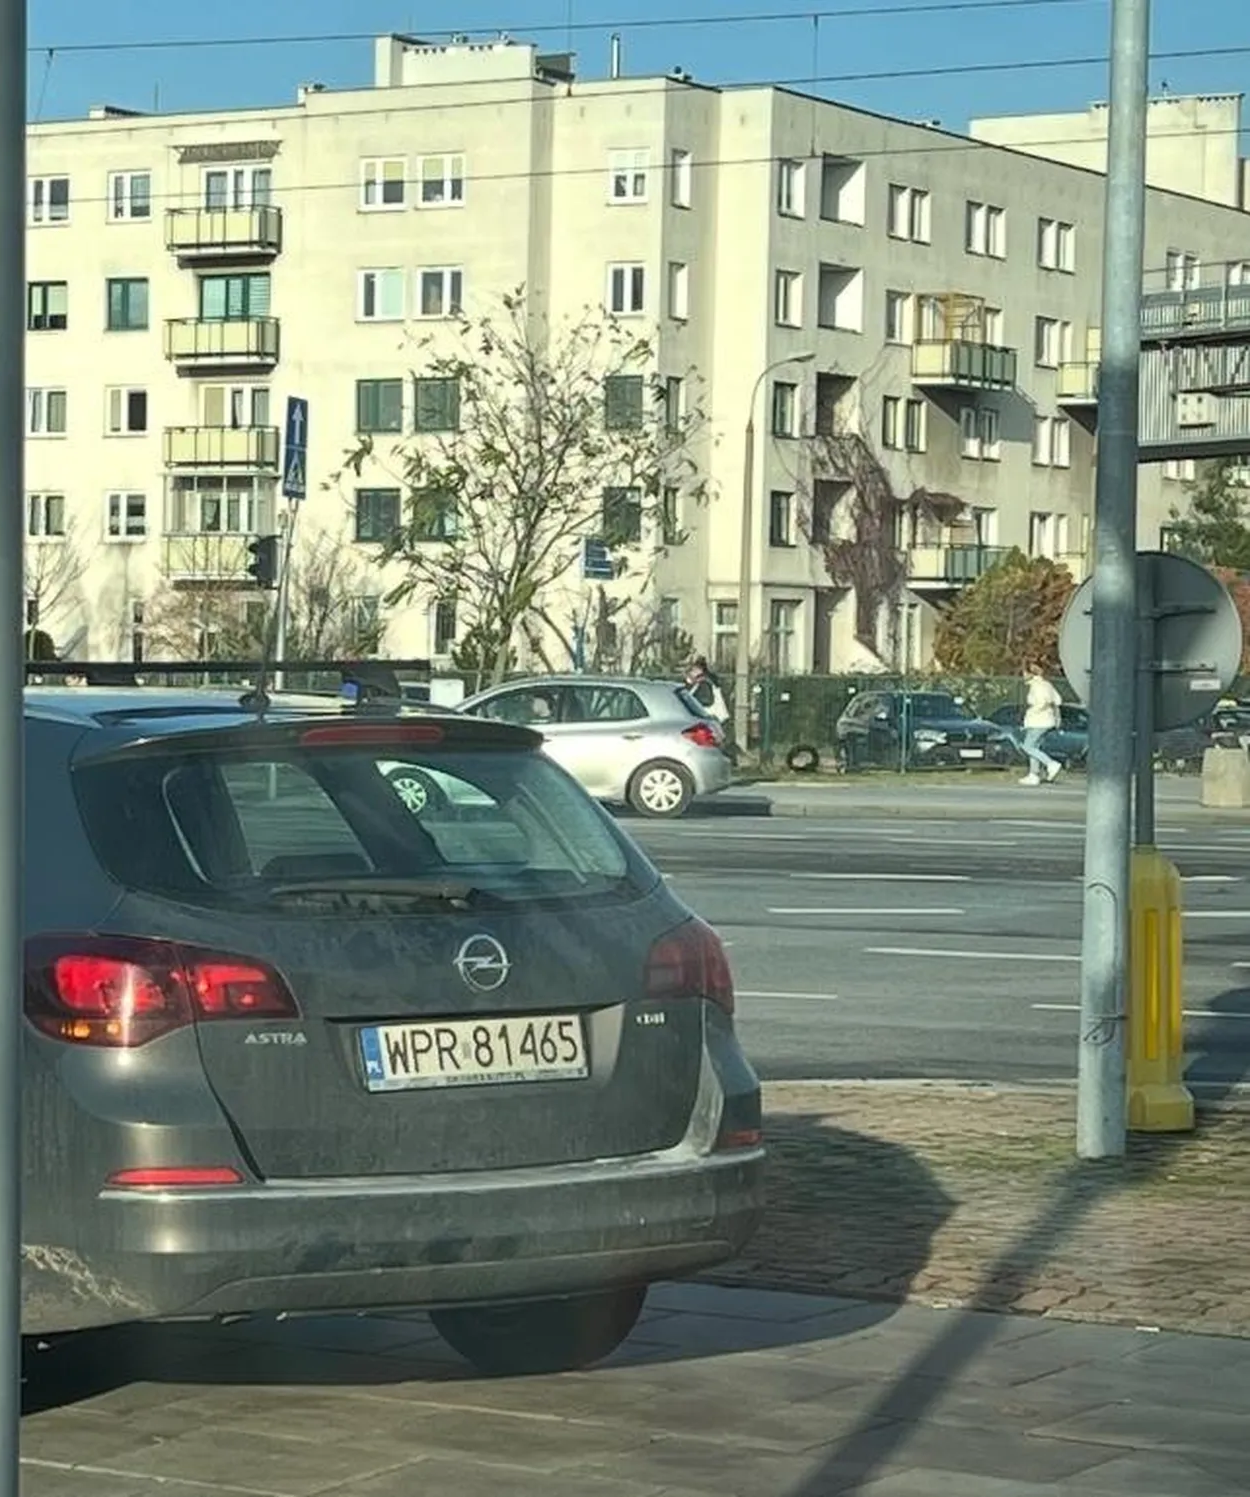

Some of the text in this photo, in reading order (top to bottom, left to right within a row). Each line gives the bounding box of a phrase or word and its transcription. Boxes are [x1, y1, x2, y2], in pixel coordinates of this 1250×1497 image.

[245, 1032, 307, 1045] ASTRA
[385, 1020, 578, 1075] WPR 81465
